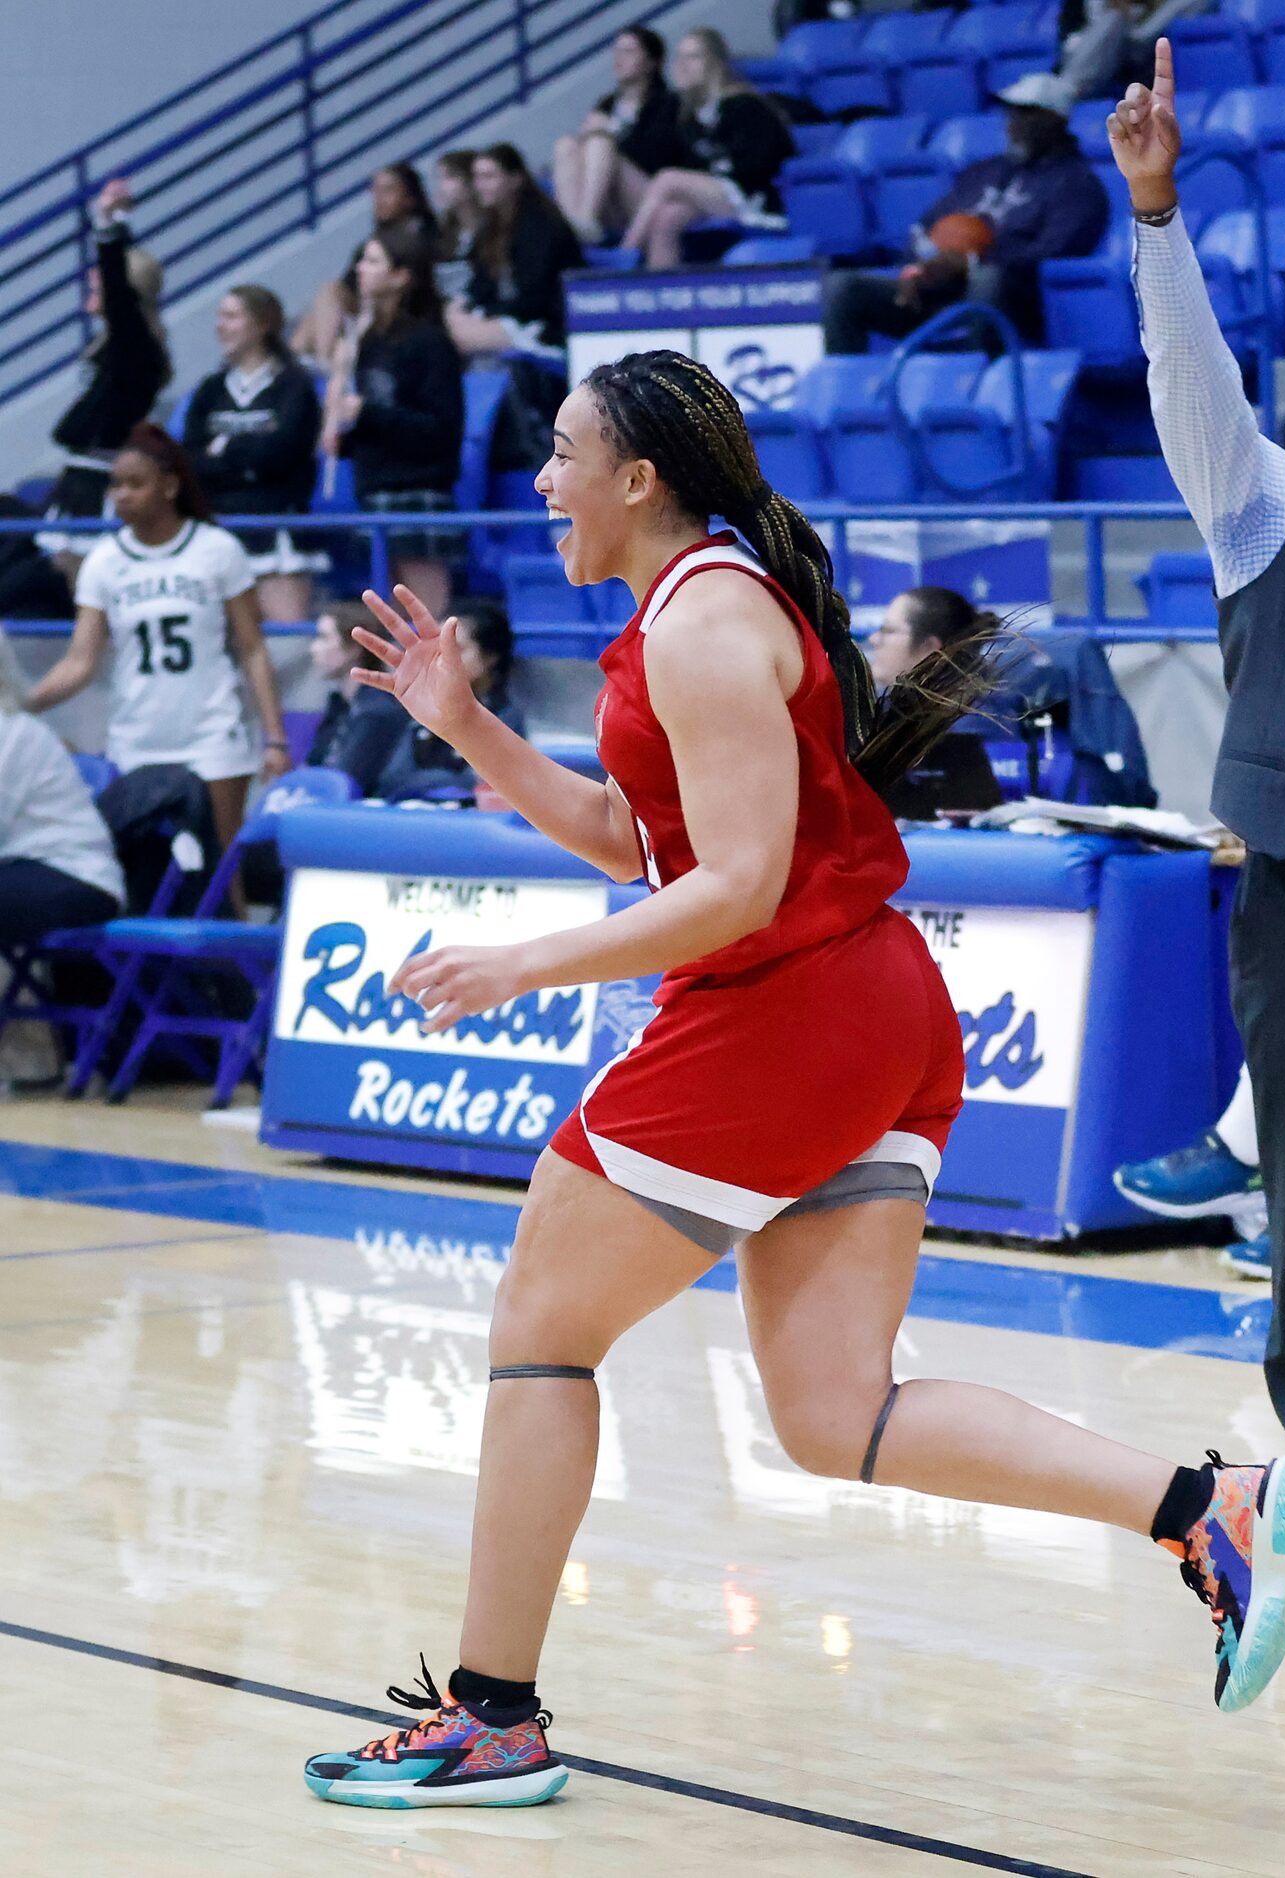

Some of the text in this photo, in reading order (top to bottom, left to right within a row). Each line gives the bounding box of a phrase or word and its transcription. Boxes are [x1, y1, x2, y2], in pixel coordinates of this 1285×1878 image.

[135, 614, 192, 675] 15
[386, 880, 518, 919] WELCOME TO
[921, 910, 963, 948] THE
[349, 1060, 556, 1140] Rockets
